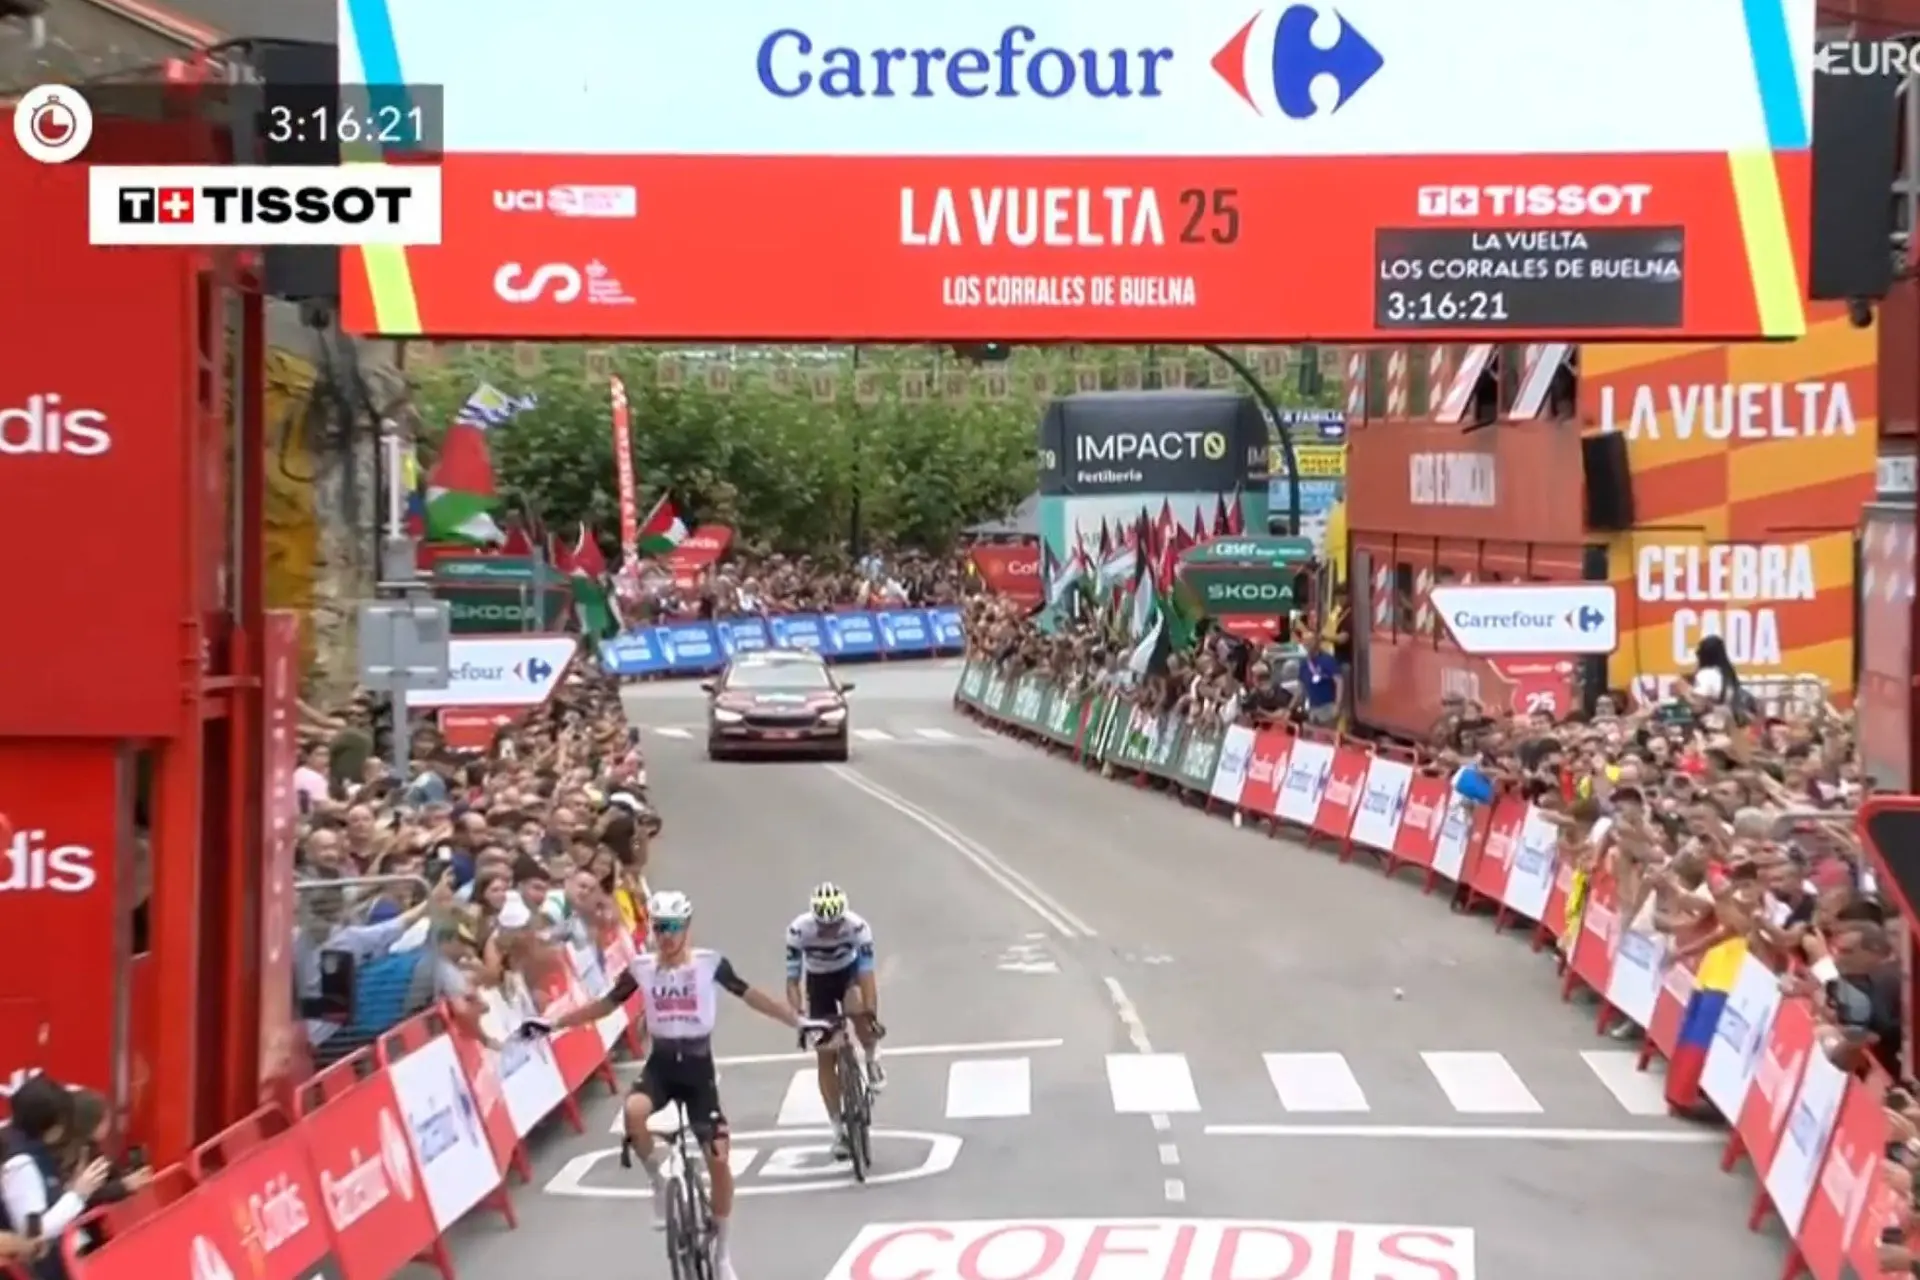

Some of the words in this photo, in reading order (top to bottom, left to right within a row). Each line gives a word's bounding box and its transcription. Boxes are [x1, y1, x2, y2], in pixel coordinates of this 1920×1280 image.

[756, 25, 1174, 98] Carrefour
[493, 189, 543, 212] UCI
[1483, 185, 1652, 215] TISSOT
[900, 187, 961, 245] LA
[970, 187, 1165, 245] VUELTA
[1178, 188, 1240, 245] 25
[1472, 232, 1501, 251] LA
[1505, 232, 1588, 251] VUELTA
[1380, 259, 1422, 279] LOS
[1428, 259, 1549, 279] CORRALES
[1554, 259, 1584, 279] DE
[1590, 259, 1681, 279] BUELNA
[943, 276, 980, 305] LOS
[985, 276, 1085, 305] CORRALES
[1091, 277, 1114, 305] DE
[1120, 277, 1196, 305] BUELNA
[1388, 292, 1508, 320] 3:16:21
[1601, 384, 1659, 440] LA
[1668, 382, 1856, 439] VUELTA
[1637, 544, 1816, 601] CELEBRA
[1454, 609, 1555, 630] Carrefour
[450, 662, 504, 680] efour
[848, 1224, 1460, 1280] COFIDIS
